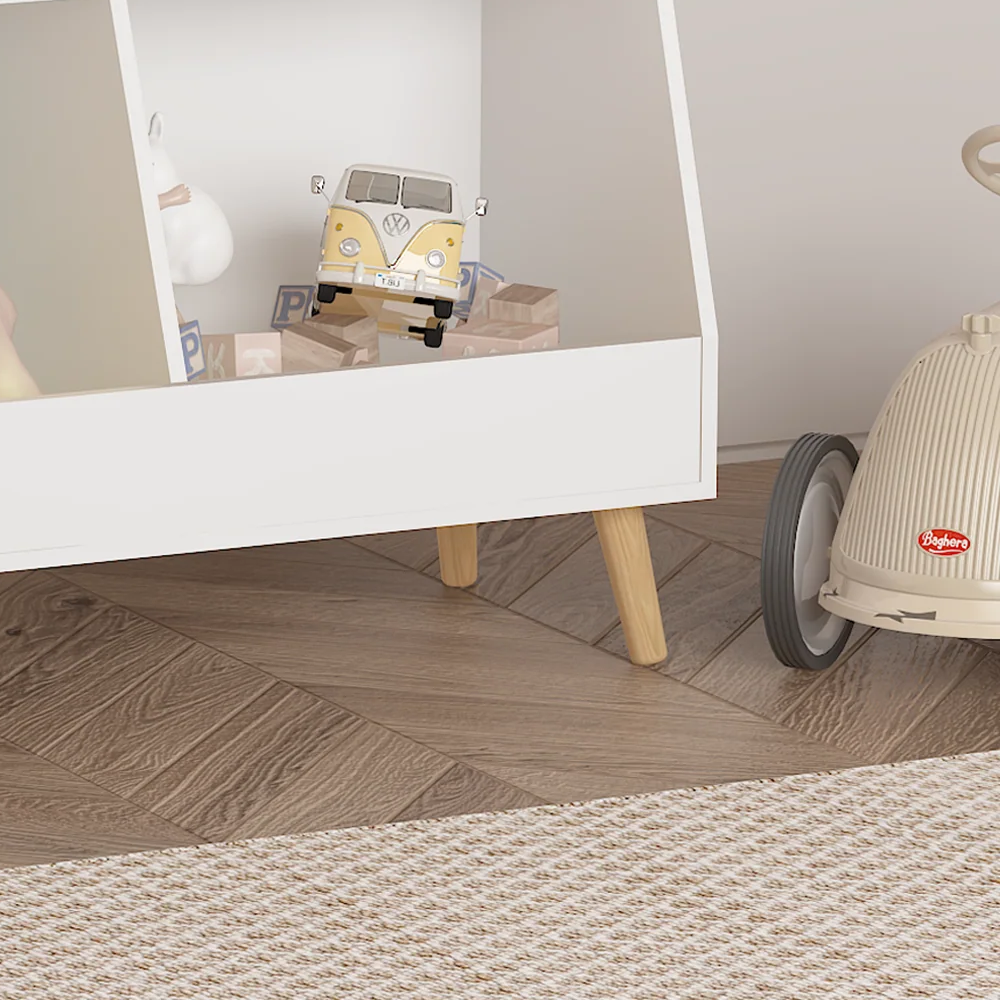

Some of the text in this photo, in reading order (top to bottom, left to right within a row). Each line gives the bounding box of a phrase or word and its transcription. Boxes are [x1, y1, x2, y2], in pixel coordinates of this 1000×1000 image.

[276, 290, 306, 322] P
[180, 331, 199, 375] P
[921, 530, 968, 550] Baghera
